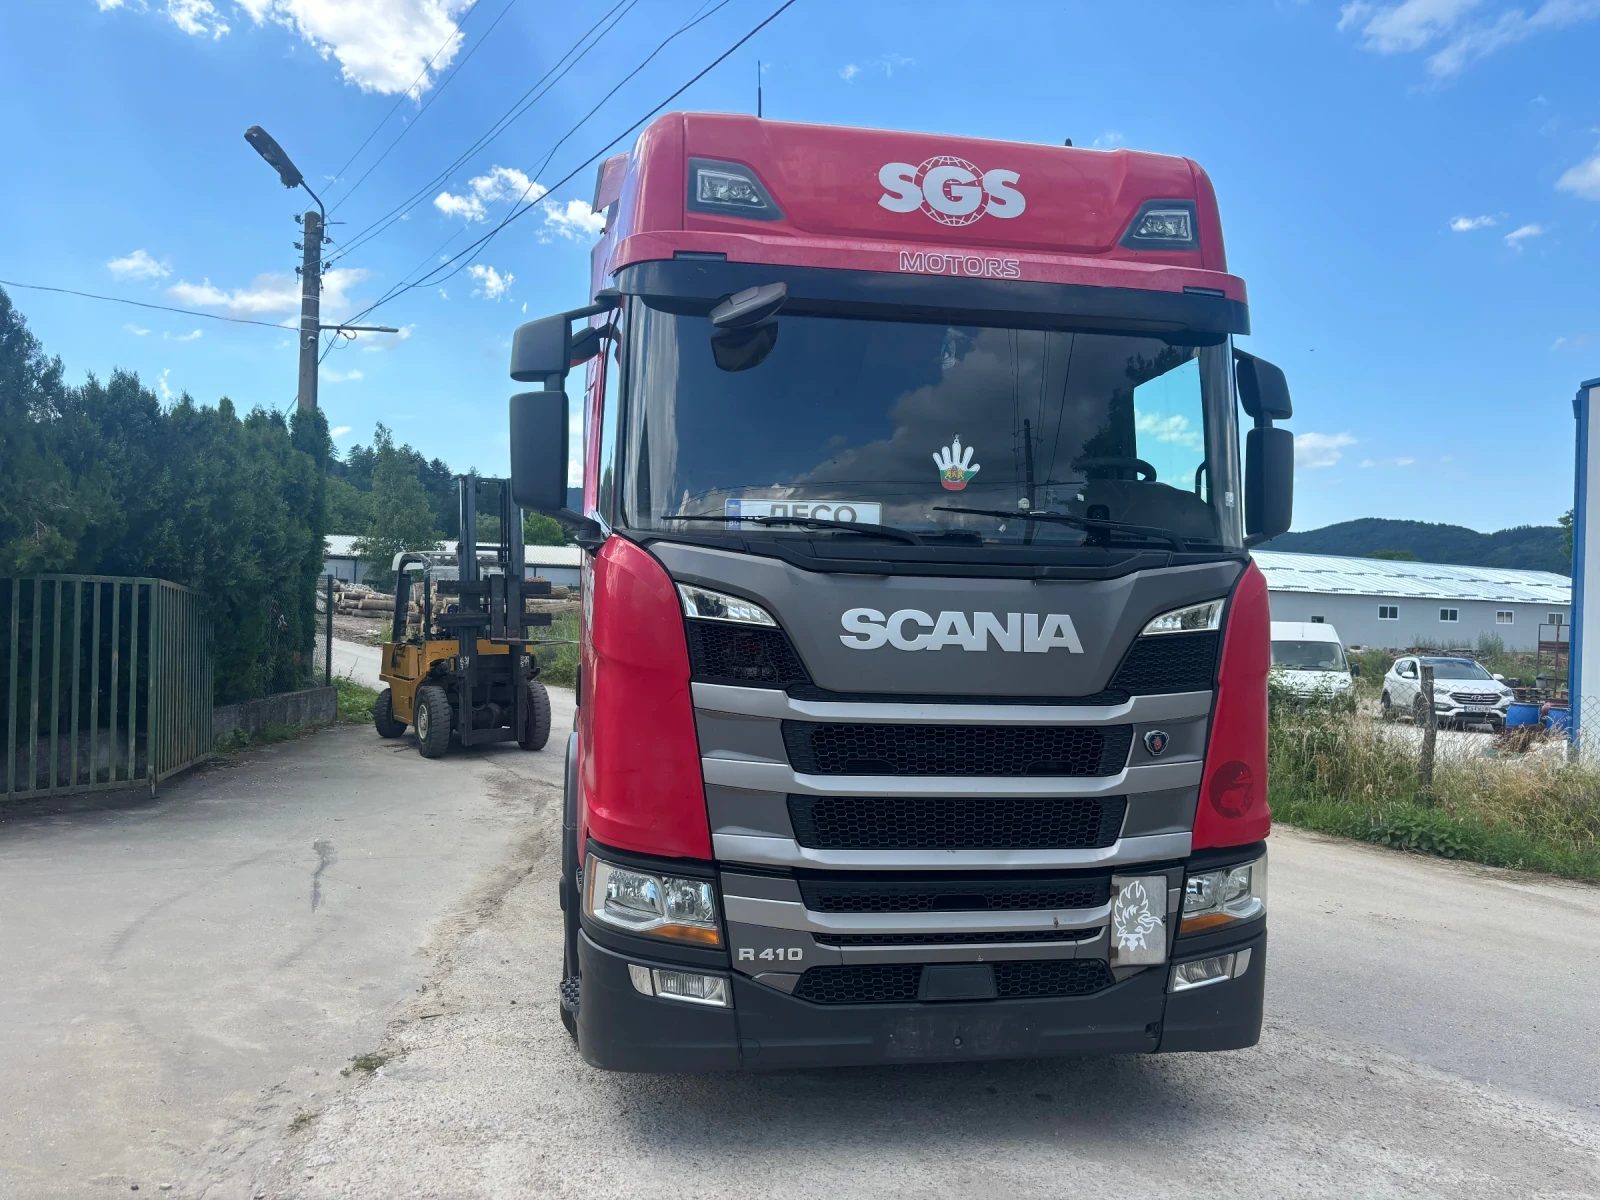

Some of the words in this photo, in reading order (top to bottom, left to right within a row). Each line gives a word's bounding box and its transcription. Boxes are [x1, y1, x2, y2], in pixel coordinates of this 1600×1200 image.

[878, 162, 1026, 219] SGS
[899, 251, 1021, 279] MOTORS
[839, 607, 1085, 654] SCANIA
[738, 948, 755, 961] R
[758, 947, 803, 961] 410
